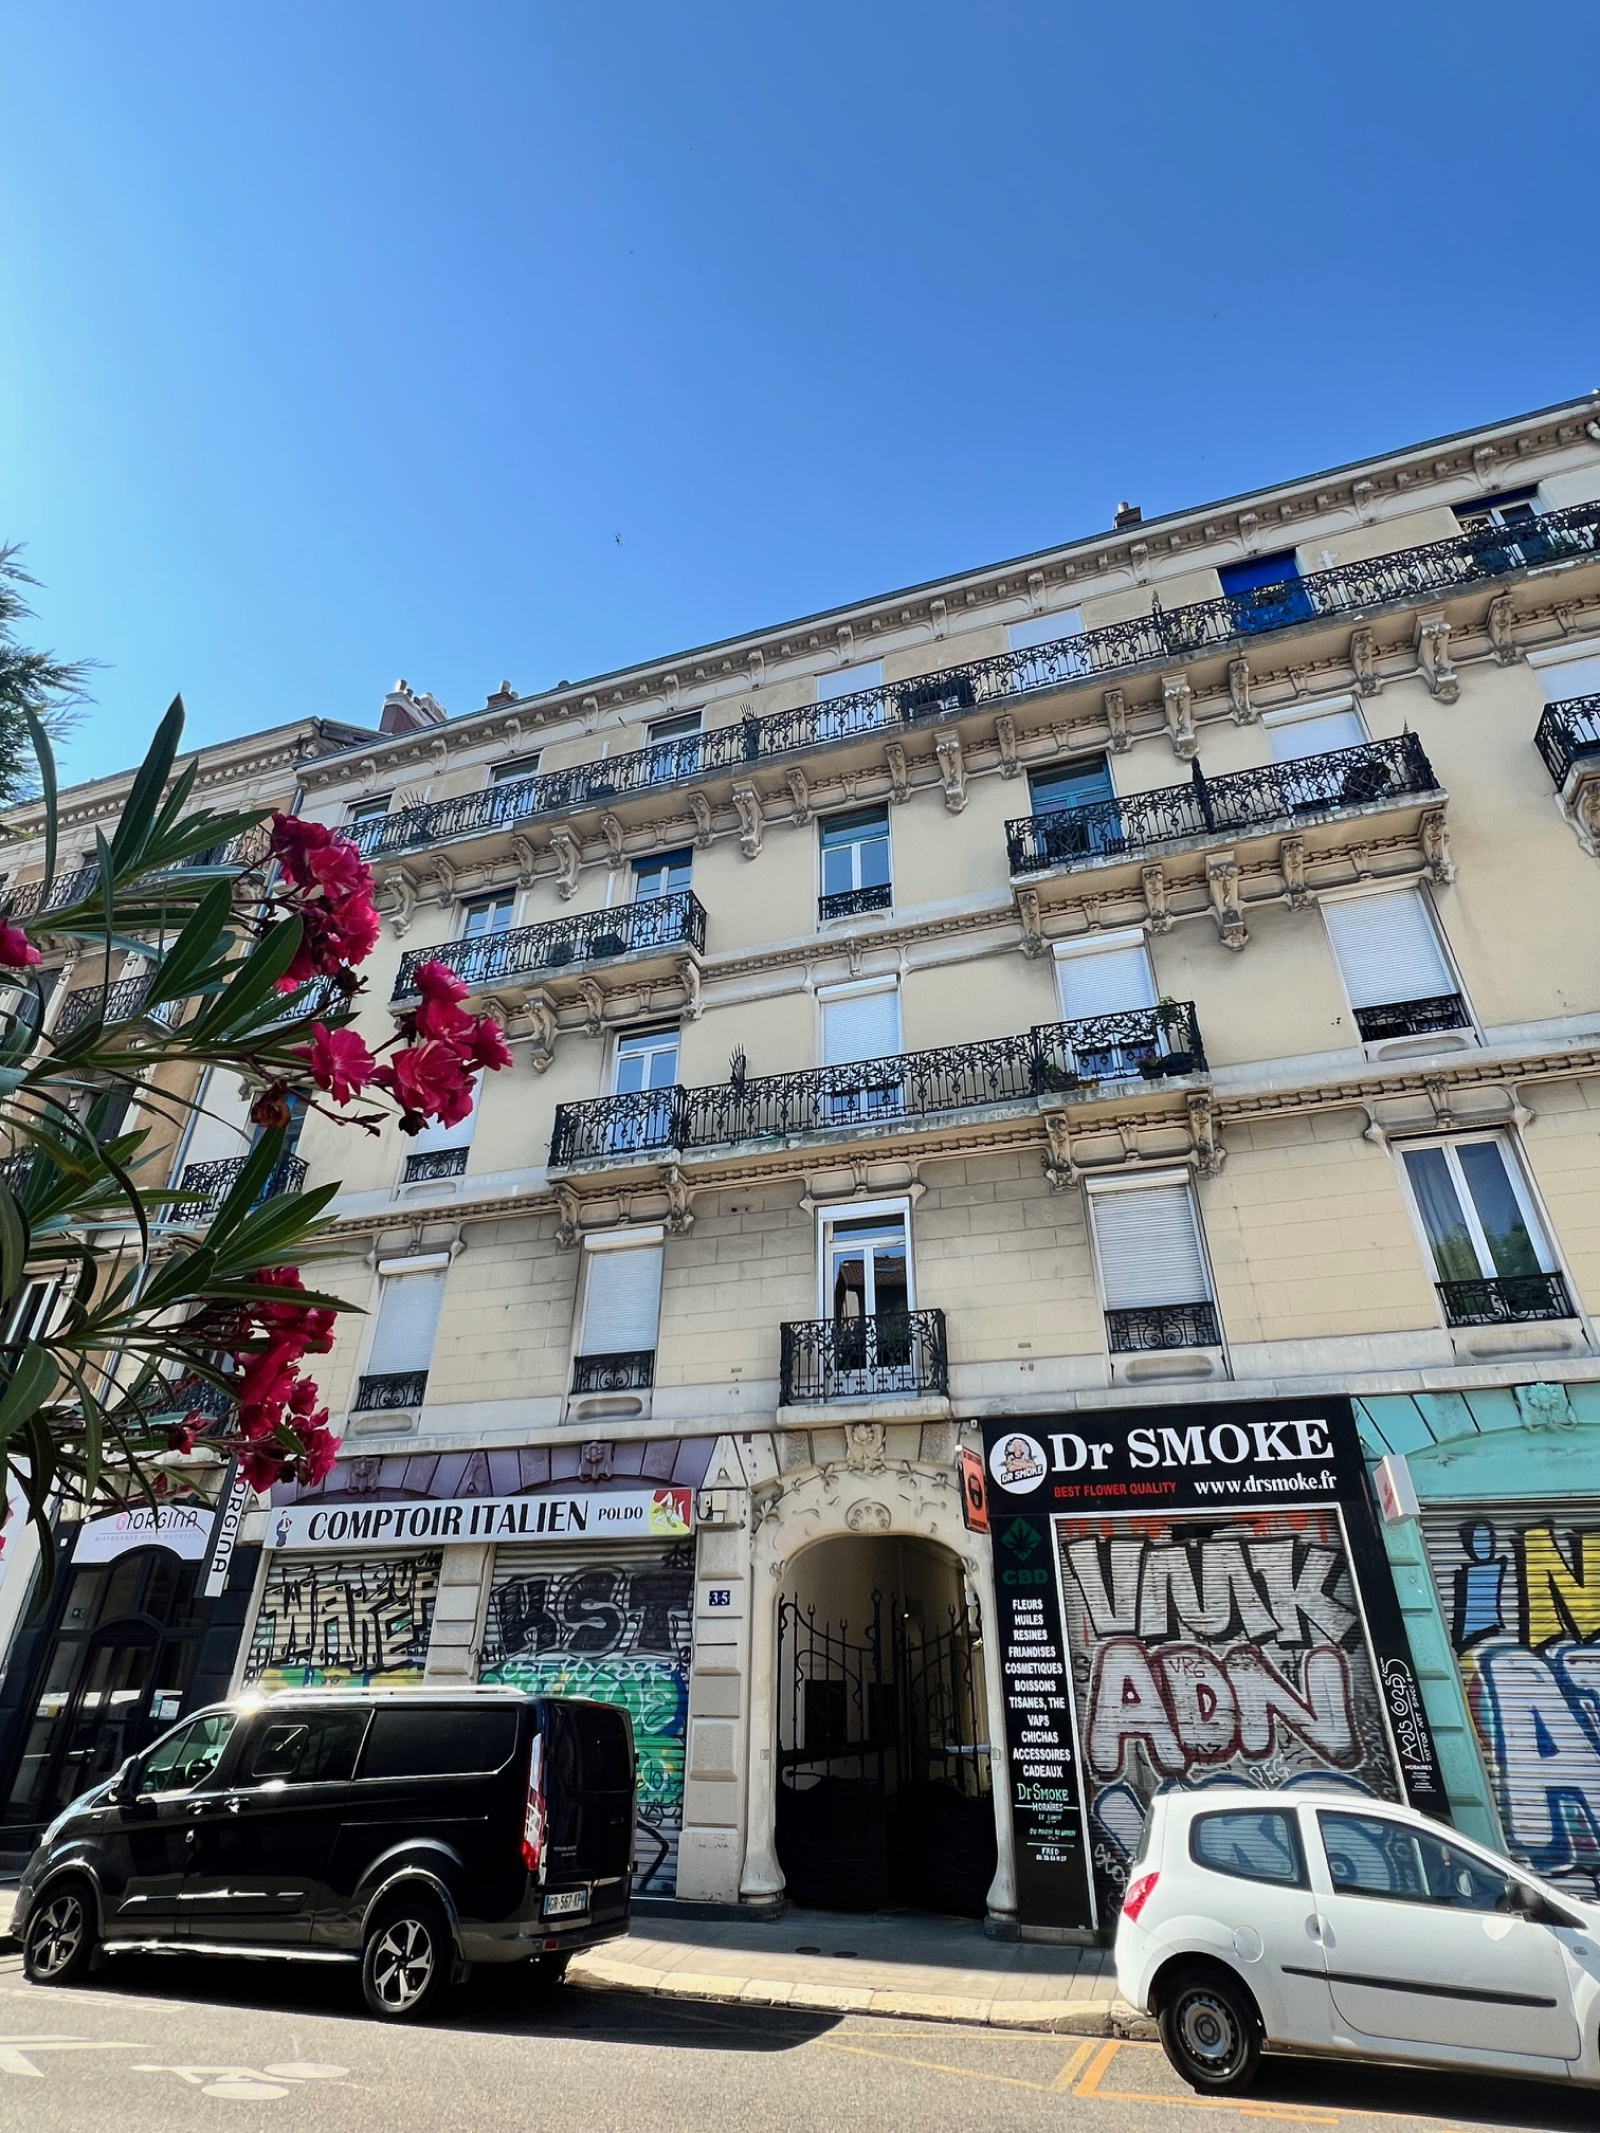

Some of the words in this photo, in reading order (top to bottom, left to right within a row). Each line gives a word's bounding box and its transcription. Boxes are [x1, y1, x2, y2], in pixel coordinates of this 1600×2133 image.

[1048, 1433, 1114, 1472] Dr
[1127, 1419, 1335, 1468] SMOKE
[1001, 1472, 1014, 1483] DR
[1014, 1465, 1043, 1481] SMOKE
[1194, 1469, 1337, 1494] www.drsmoke.fr
[1054, 1486, 1080, 1498] BEST
[1084, 1484, 1127, 1497] FLOWER
[1130, 1482, 1176, 1495] QUALITY
[115, 1511, 199, 1531] GIORGINA
[211, 1467, 248, 1573] ORGINA
[308, 1506, 463, 1541] COMPTOIR
[469, 1500, 589, 1535] ITALIEN
[598, 1506, 643, 1522] POLDO
[1002, 1569, 1049, 1586] CBD
[711, 1591, 728, 1605] 35
[1012, 1599, 1043, 1610] FLEURS
[1015, 1614, 1044, 1625] HUILES
[1013, 1629, 1048, 1641] RESINES
[1008, 1646, 1056, 1658] FRIANDISES
[1005, 1663, 1063, 1675] COSMETIQUES
[1015, 1680, 1056, 1692] BOISSONS
[1009, 1697, 1047, 1711] TISANES,
[1048, 1697, 1066, 1709] THE
[1085, 1634, 1366, 1783] ADN
[1027, 1714, 1050, 1727] VAPS
[1415, 1712, 1424, 1728] ART
[1021, 1731, 1059, 1743] CHICHAS
[1420, 1731, 1432, 1762] TATTOO
[1013, 1747, 1071, 1761] ACCESSOIRES
[1023, 1765, 1063, 1778] CADEAUX
[1032, 1801, 1063, 1812] HORAIRES
